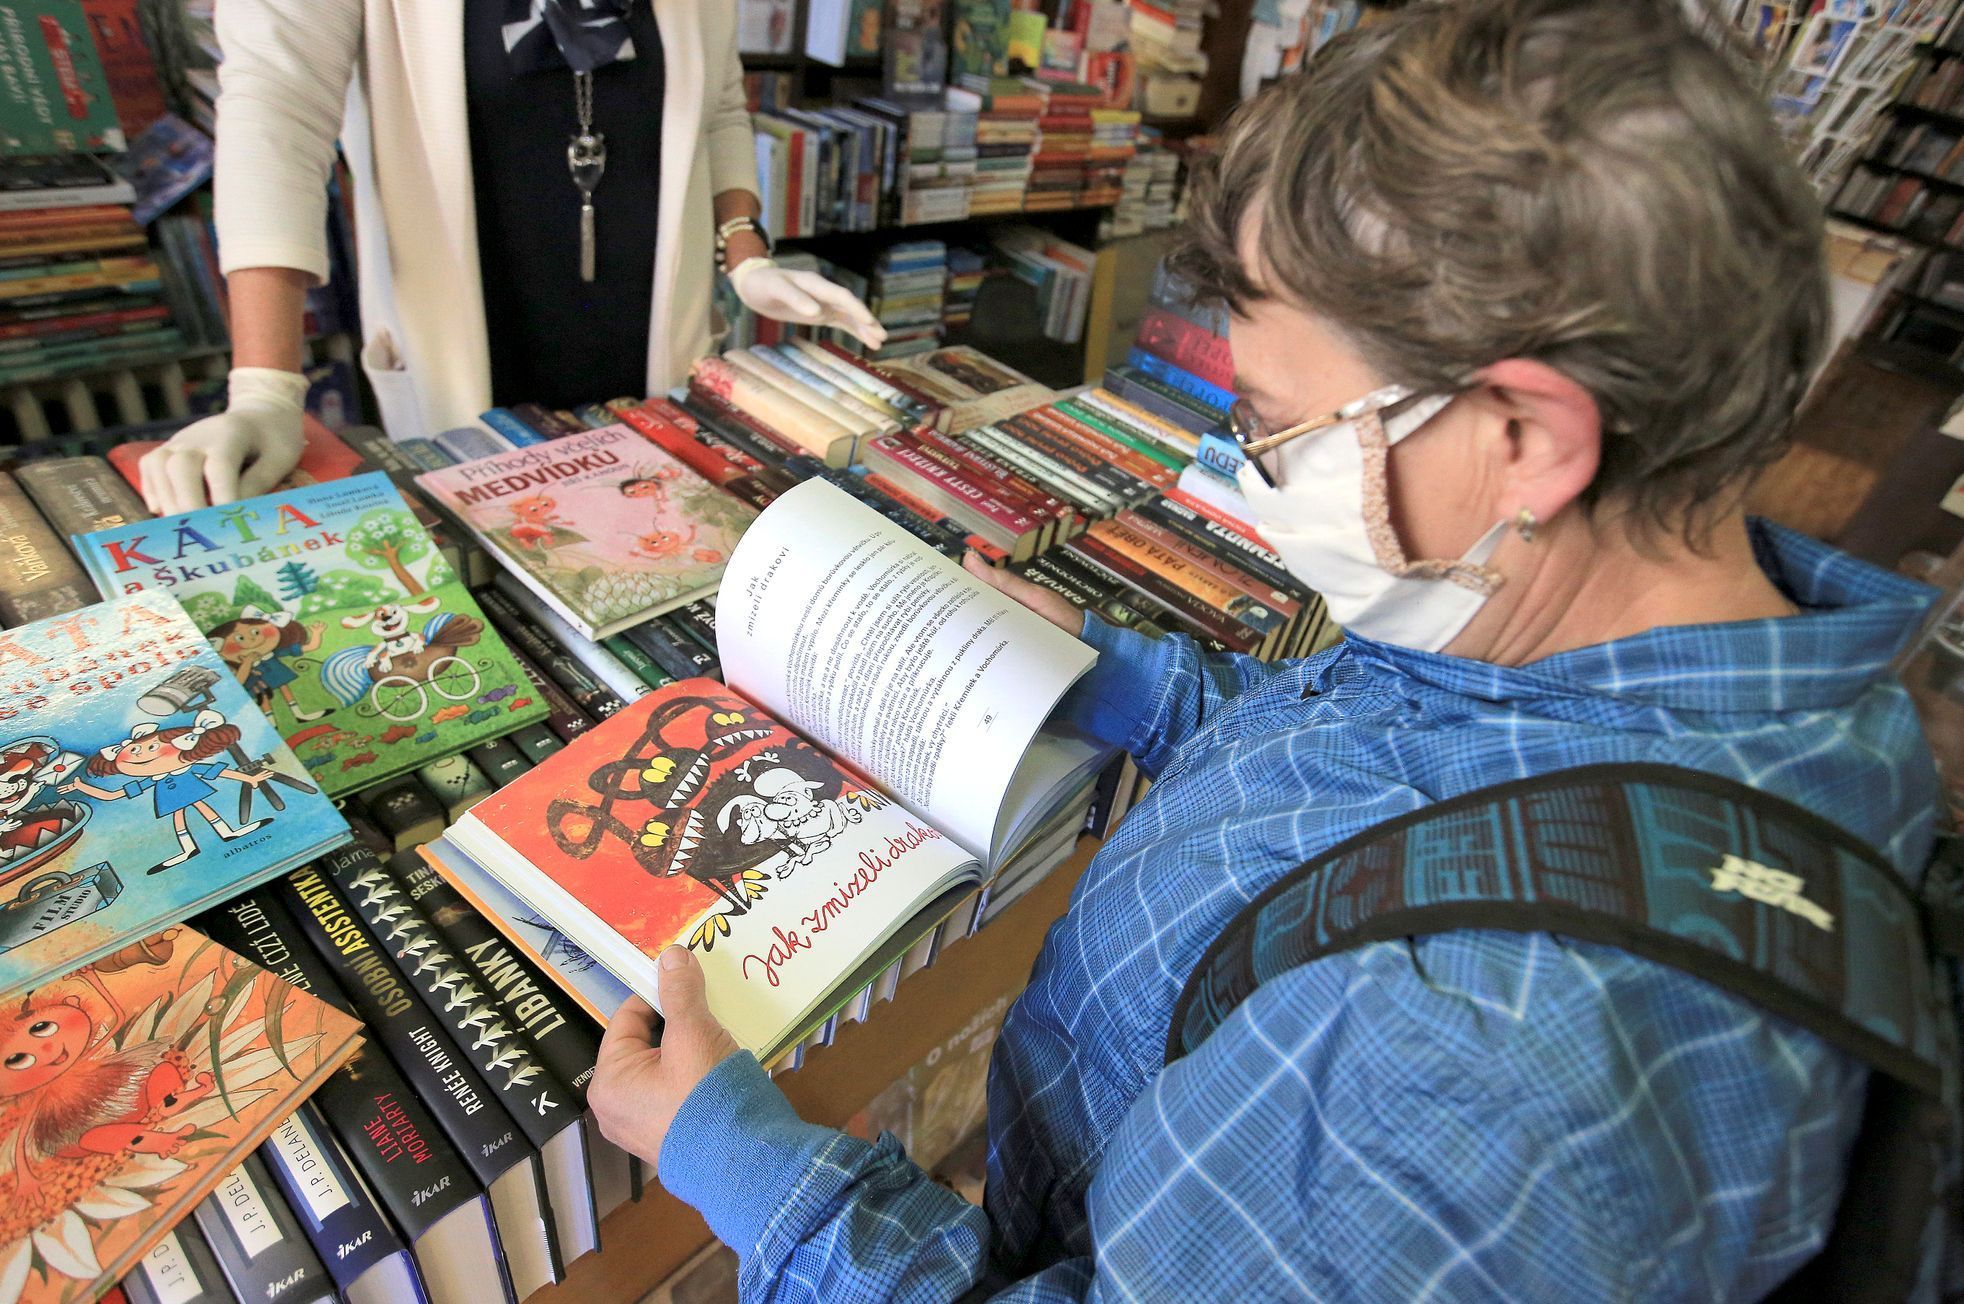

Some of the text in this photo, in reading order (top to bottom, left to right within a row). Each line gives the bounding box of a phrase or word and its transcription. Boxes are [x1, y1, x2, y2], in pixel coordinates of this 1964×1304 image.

[453, 447, 620, 506] MEDVÍDKŮ
[459, 429, 628, 482] Příhody včelích
[1203, 446, 1243, 476] EDU
[101, 504, 322, 573] KÁŤA
[153, 530, 346, 587] Škubánek
[747, 574, 760, 596] Jak
[747, 545, 791, 636] zmizeli drakovi
[809, 583, 825, 605] domů
[816, 607, 829, 626] Mezi
[830, 615, 854, 655] dosáhnout
[223, 833, 273, 859] albatros
[32, 893, 73, 932] FILM
[61, 888, 92, 921] STUDIO
[743, 848, 892, 987] Jak zmizeli
[228, 899, 291, 966] CIZÍ LIDÉ
[288, 865, 412, 1017] OSOBNÍ ASISTENTKA
[465, 937, 566, 1041] LÍBÁNKY
[408, 1026, 484, 1116] RENÉE KNIGHT
[276, 1117, 317, 1173] DELANE
[363, 1115, 404, 1164] LIANE
[374, 1092, 433, 1164] MORIARTY
[225, 1171, 250, 1207] DELA
